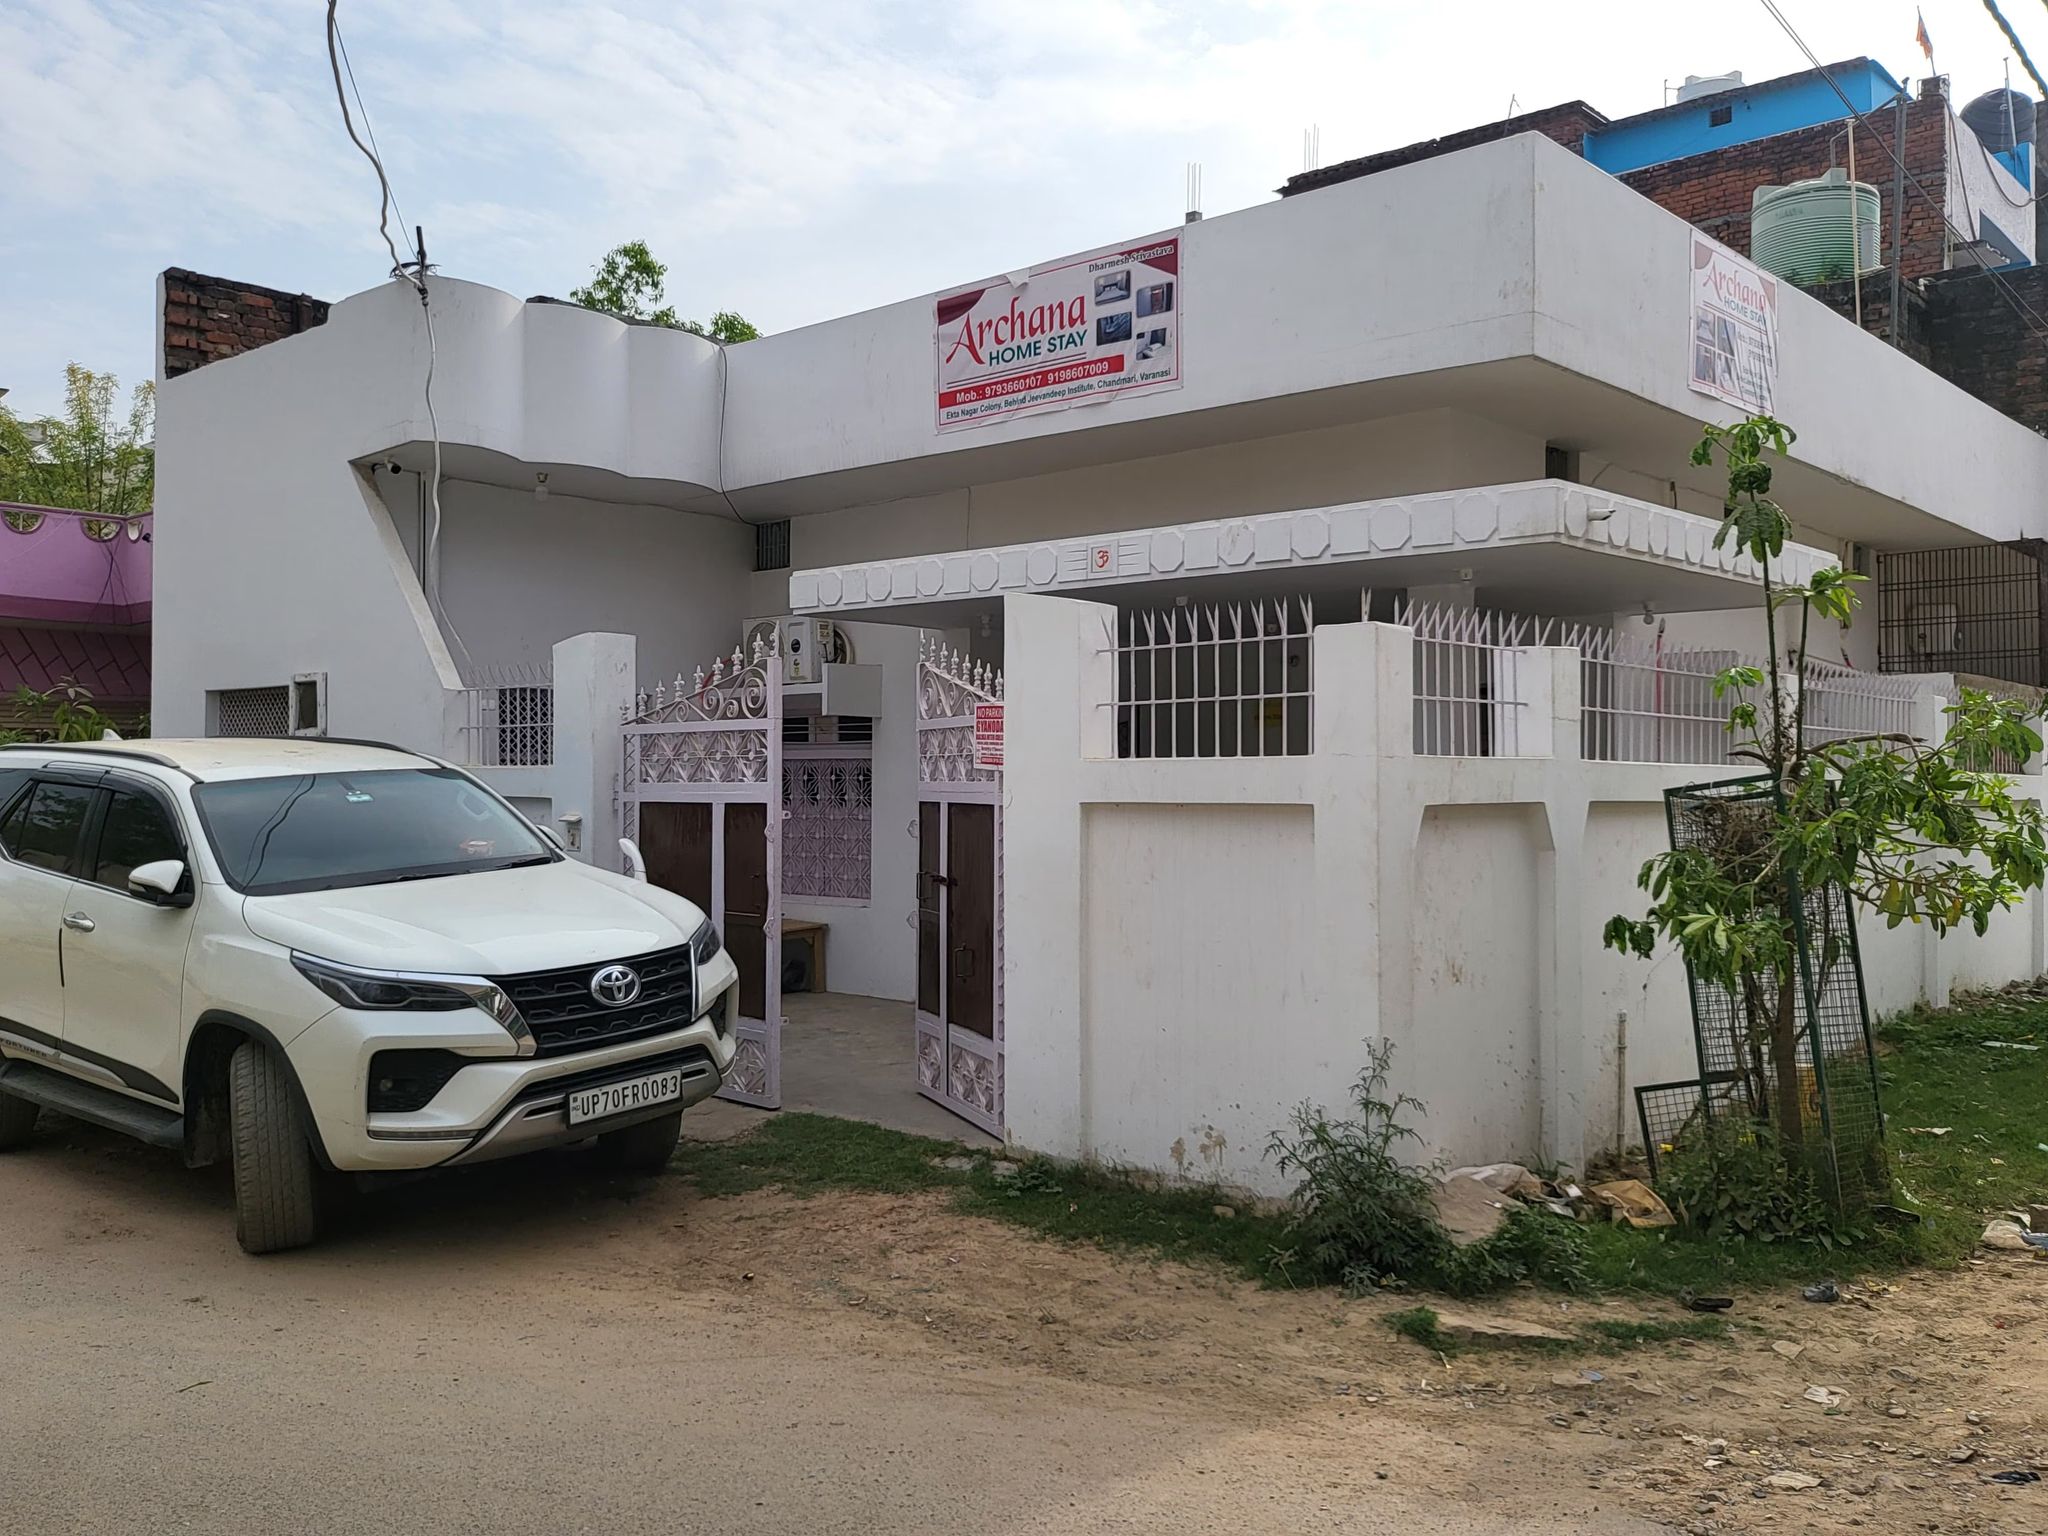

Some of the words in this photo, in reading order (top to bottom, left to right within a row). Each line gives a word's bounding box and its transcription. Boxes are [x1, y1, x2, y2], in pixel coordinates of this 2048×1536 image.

[1088, 255, 1130, 273] Dharmesh
[1130, 245, 1174, 262] Srivastava
[1724, 296, 1748, 318] HOME
[946, 295, 1087, 365] Archana
[989, 340, 1042, 367] HOME
[1047, 329, 1088, 353] STAY
[946, 410, 960, 420] Ekta
[960, 406, 979, 416] Nagar
[1004, 393, 1026, 408] Behind
[1028, 387, 1067, 403] Jeevandeep
[1139, 367, 1171, 381] Varanasi
[985, 375, 1042, 398] 9793660107
[1047, 361, 1109, 384] 9198607009
[581, 1075, 678, 1116] UP70FR0083
